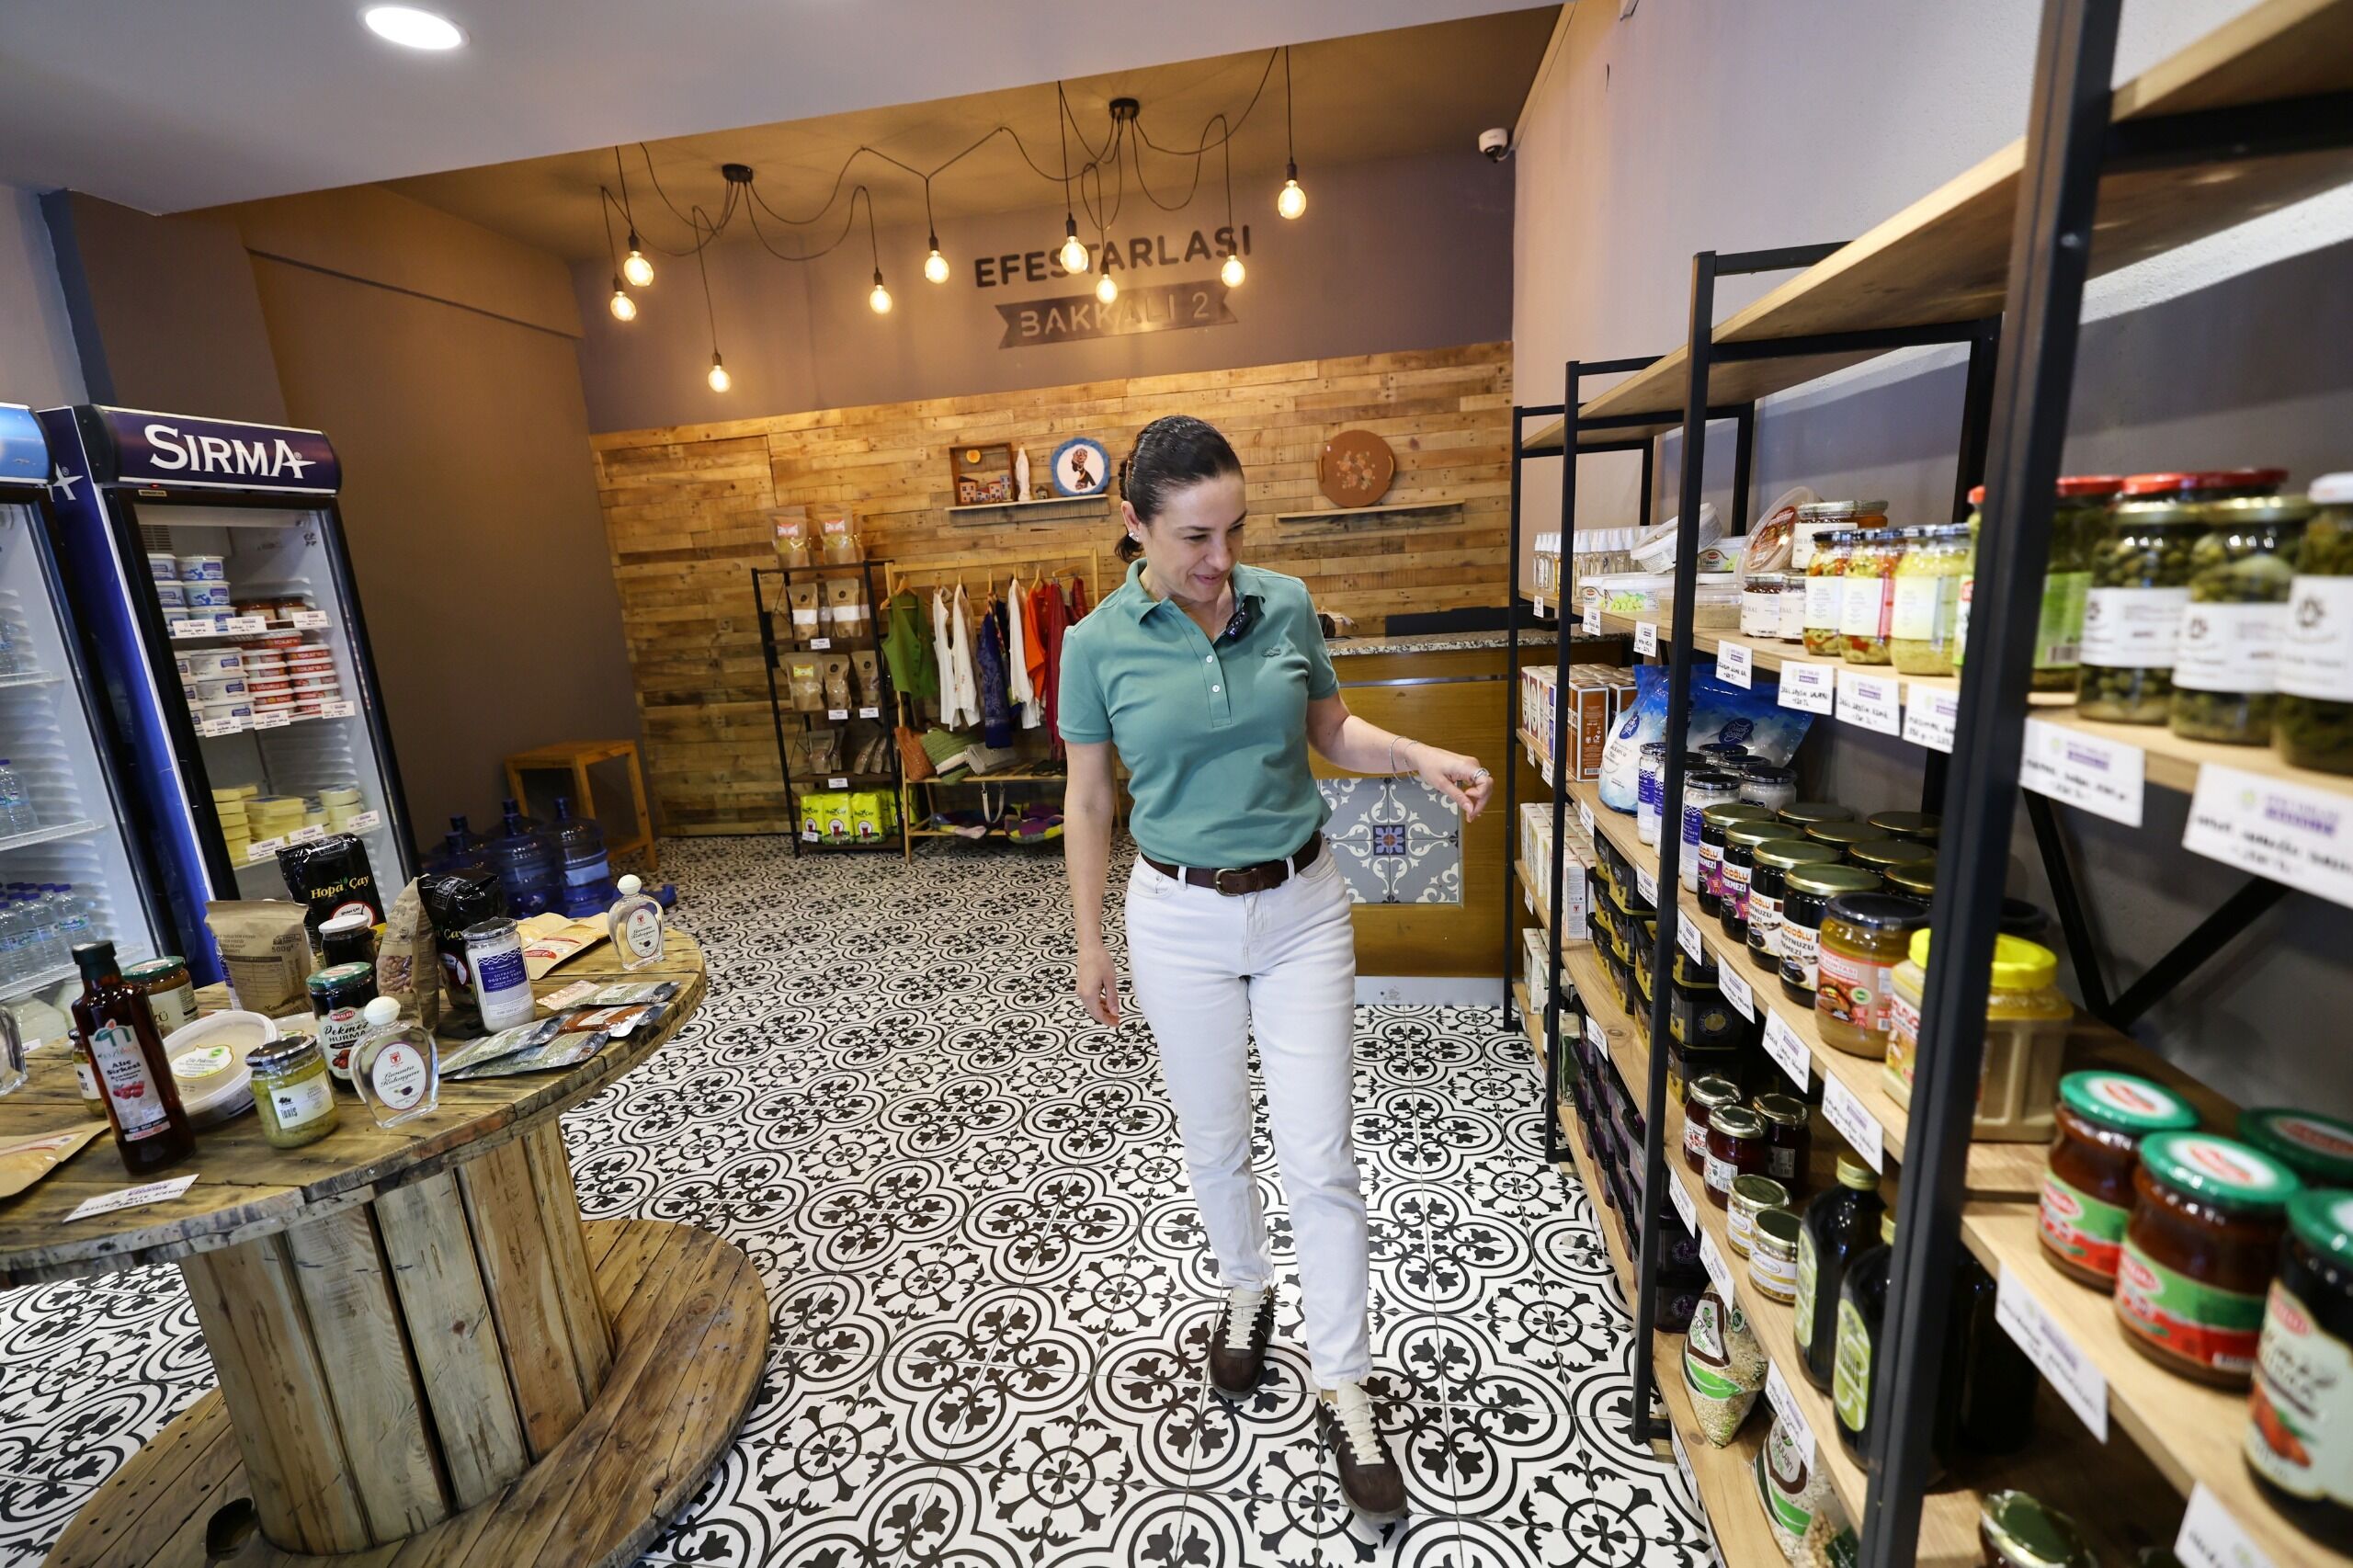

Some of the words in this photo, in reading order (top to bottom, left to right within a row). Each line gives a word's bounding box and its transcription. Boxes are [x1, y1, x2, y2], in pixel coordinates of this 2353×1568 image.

[1020, 293, 1175, 337] BAKKALI
[1192, 291, 1209, 318] 2
[144, 424, 316, 479] SIRMA
[311, 884, 344, 899] Hopa
[349, 875, 369, 890] Çay
[324, 1022, 369, 1036] Pekmez
[329, 1030, 365, 1042] HURMA
